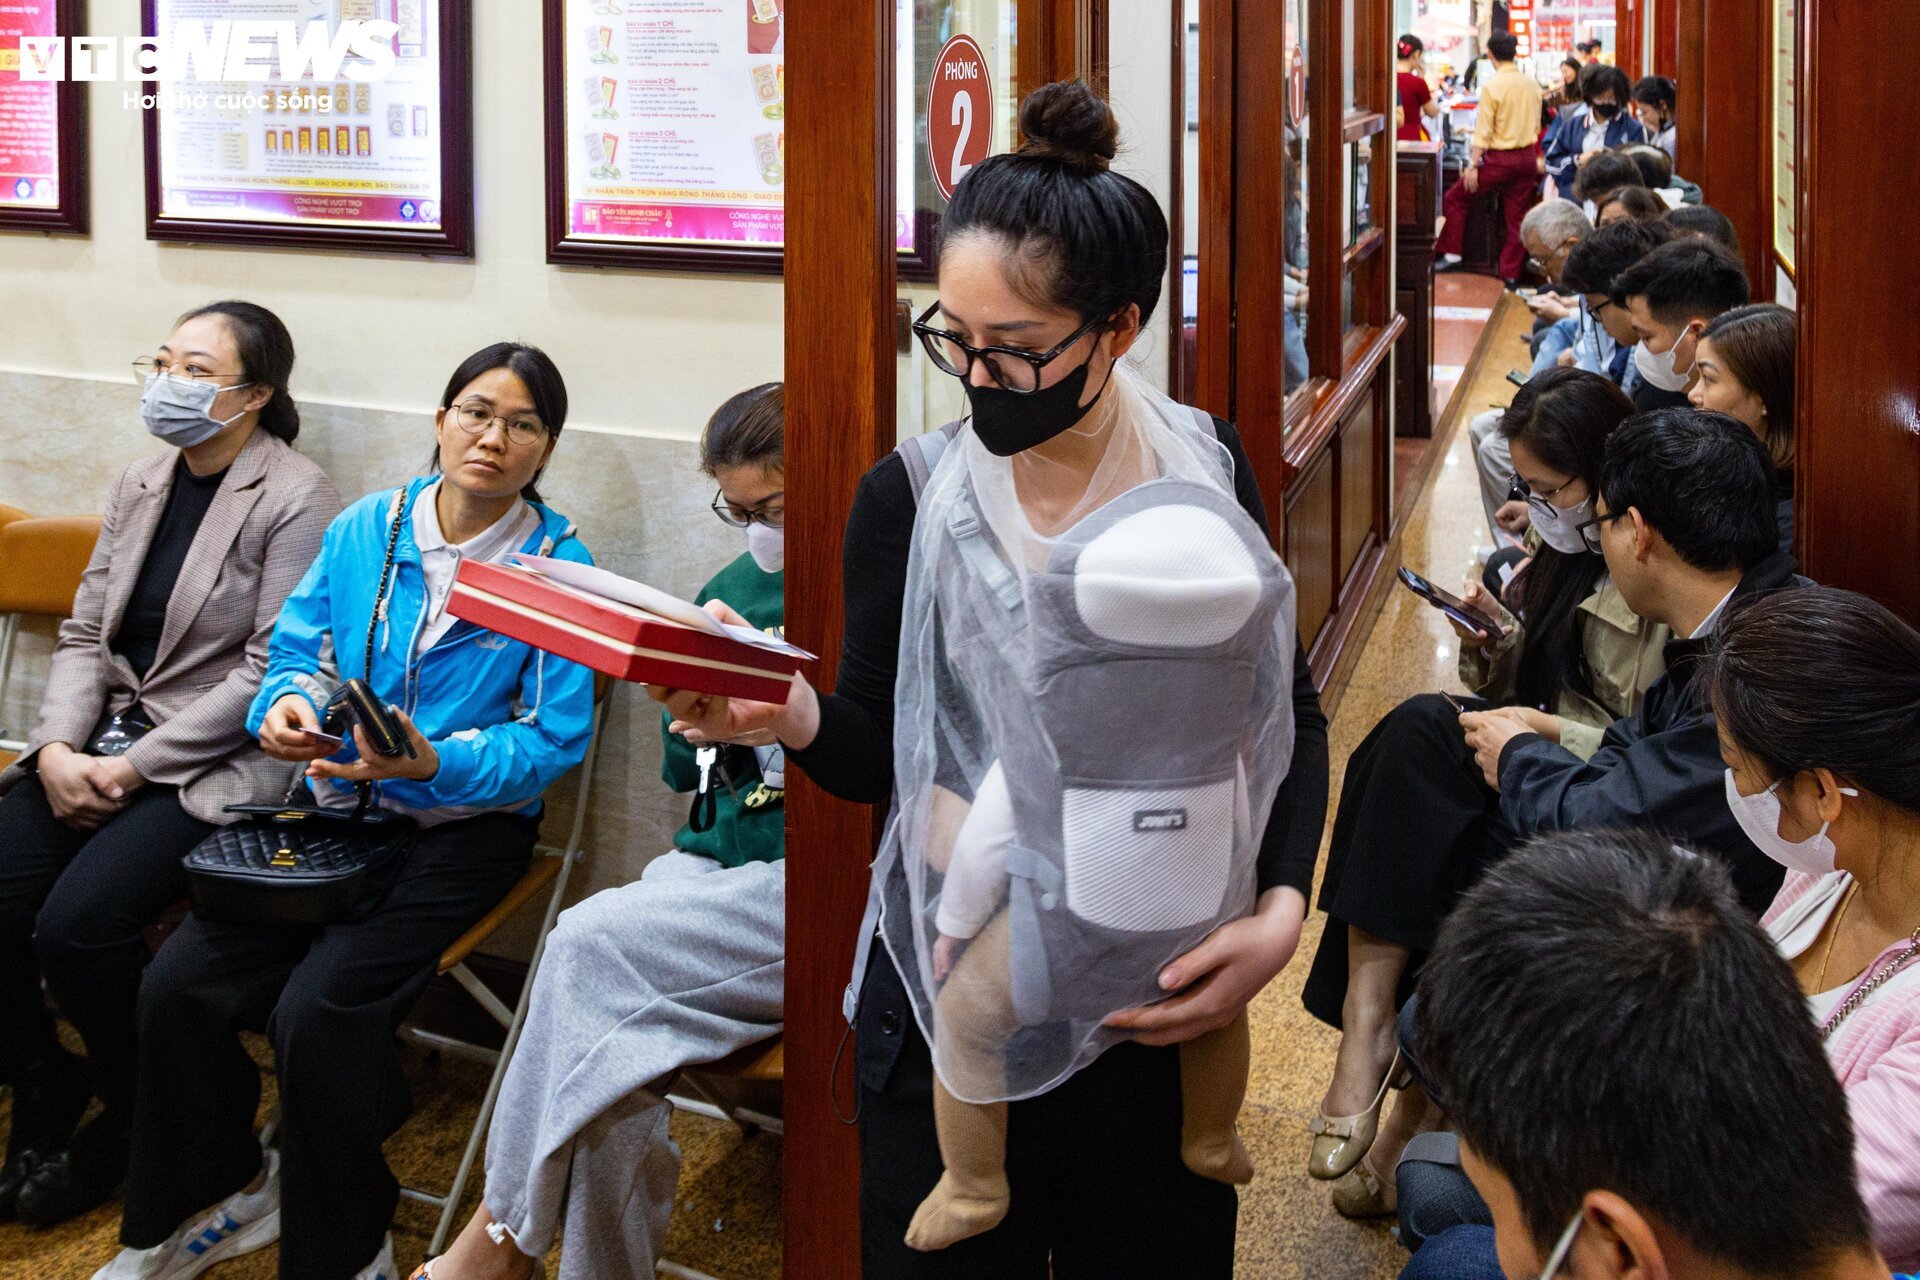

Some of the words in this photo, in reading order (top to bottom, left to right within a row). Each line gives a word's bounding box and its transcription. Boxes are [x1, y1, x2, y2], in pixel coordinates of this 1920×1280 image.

[945, 58, 978, 81] PHÒNG
[1294, 71, 1299, 119] 1
[951, 90, 973, 186] 2
